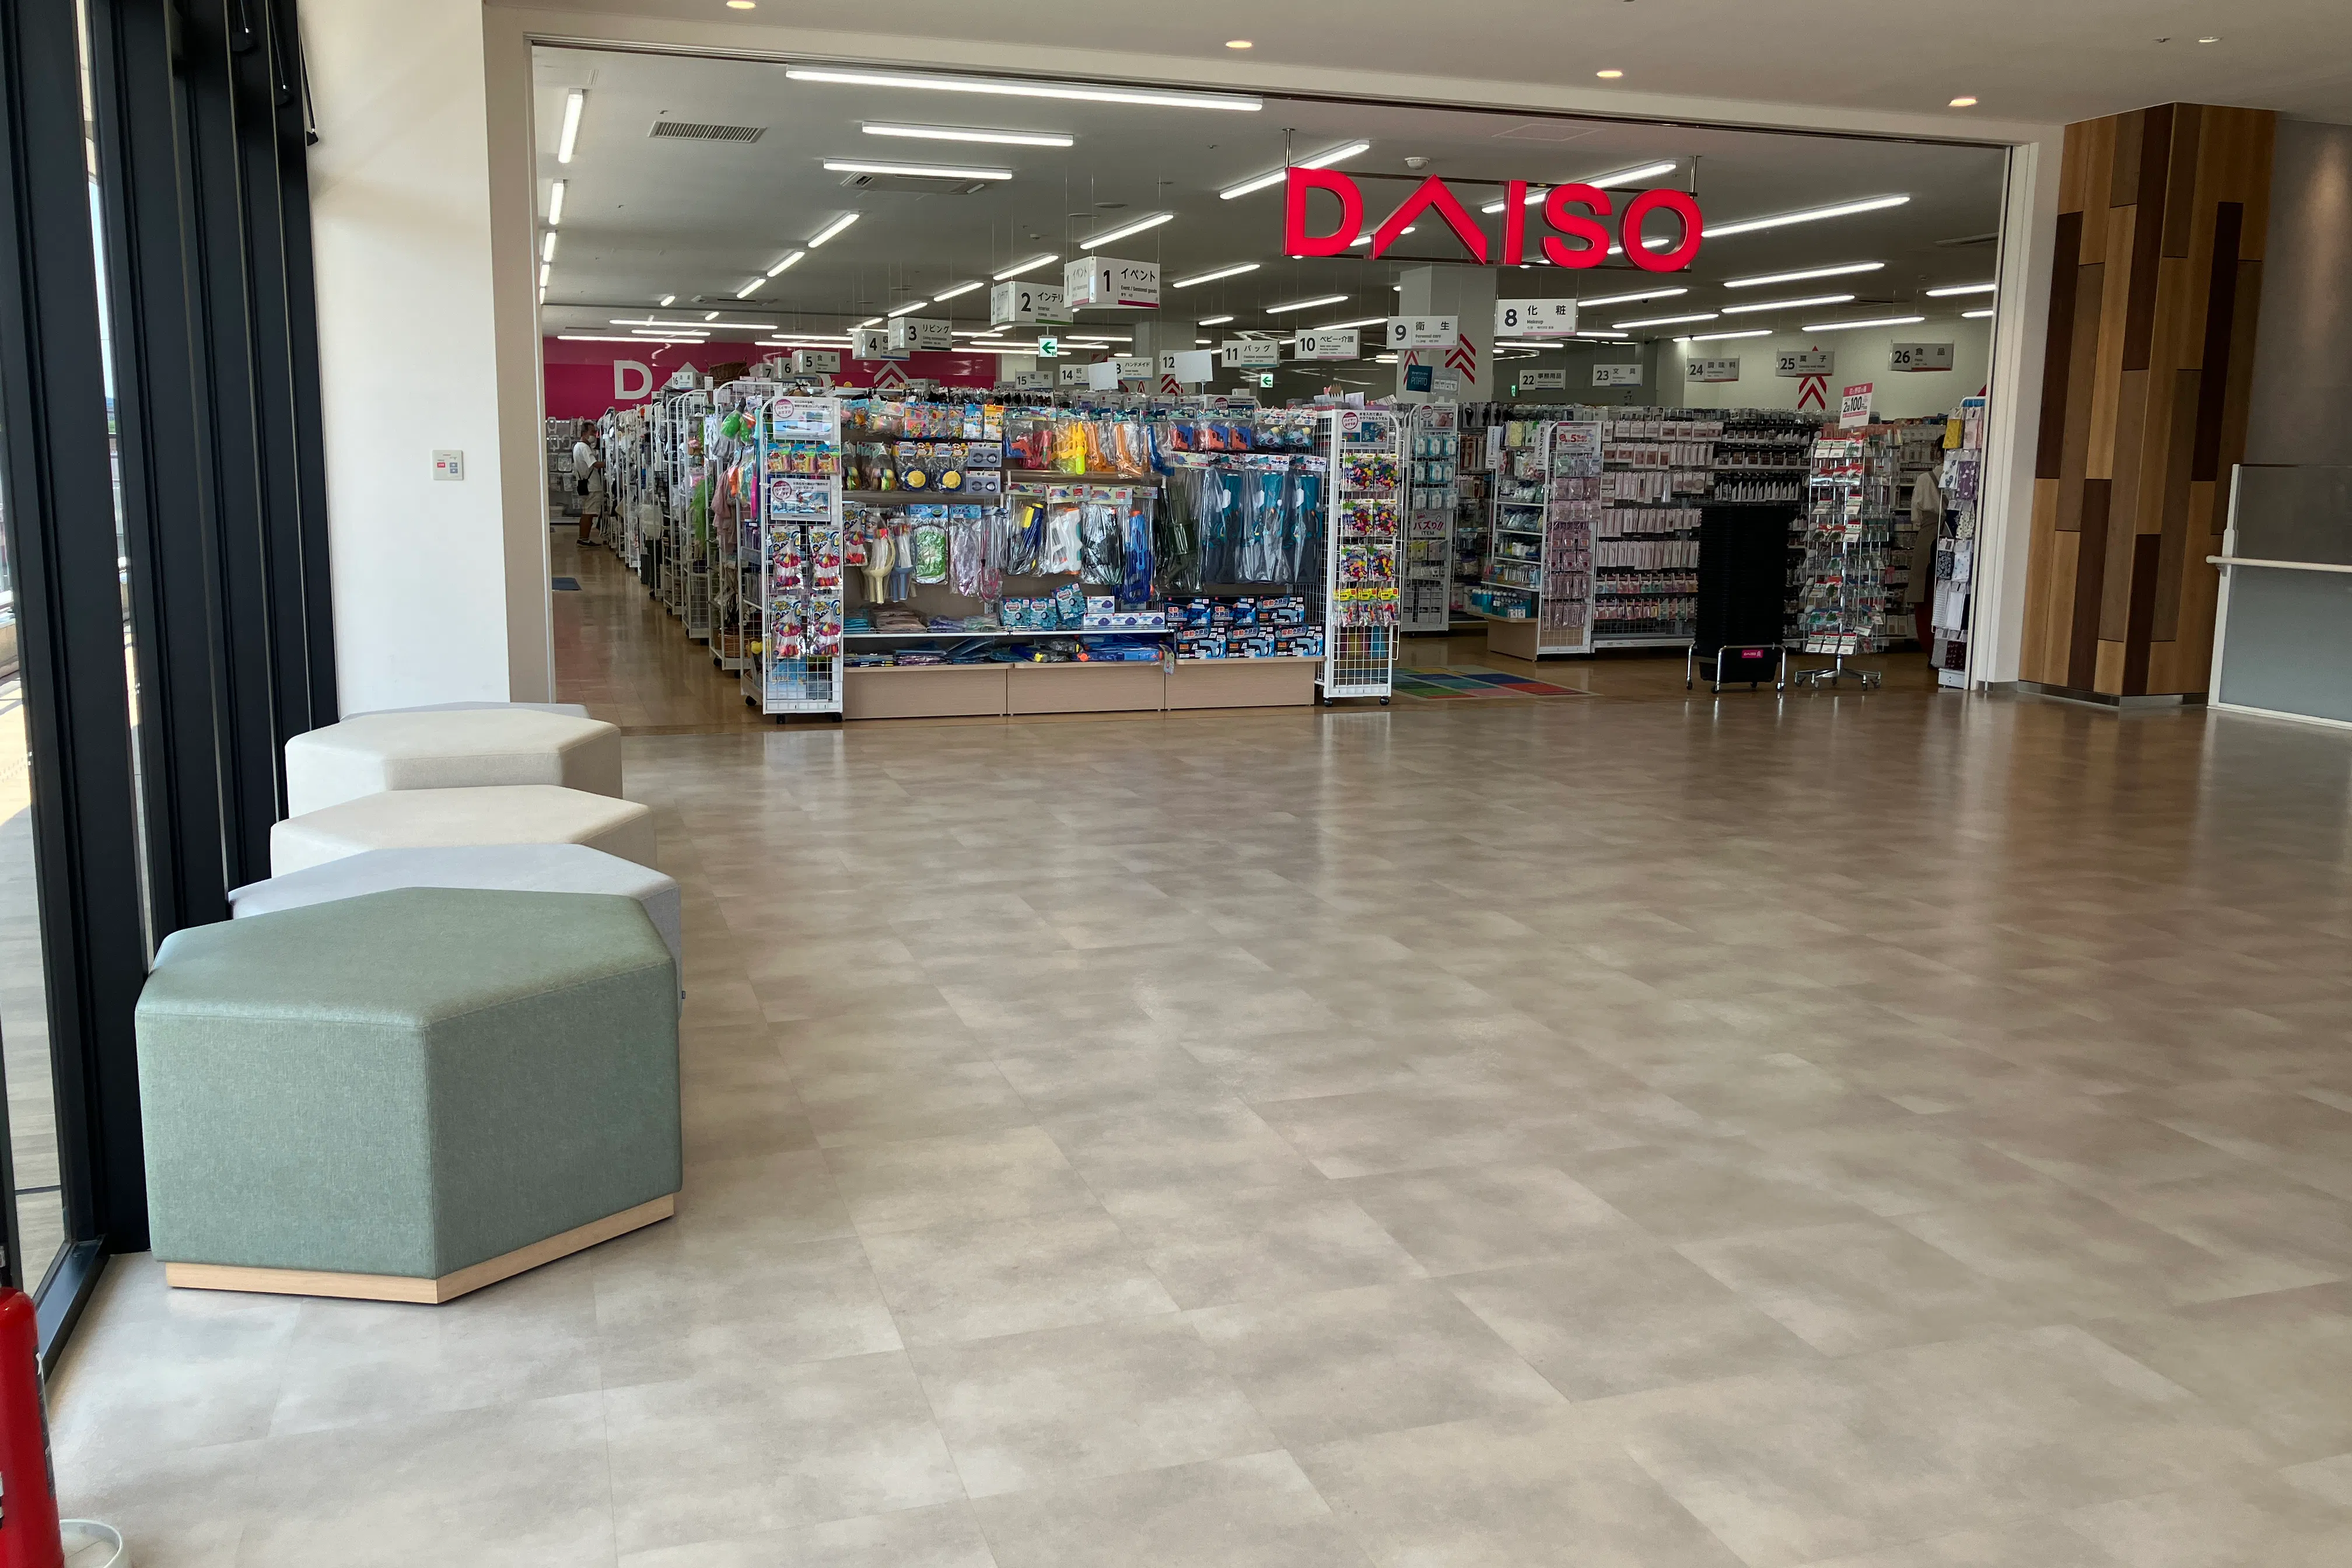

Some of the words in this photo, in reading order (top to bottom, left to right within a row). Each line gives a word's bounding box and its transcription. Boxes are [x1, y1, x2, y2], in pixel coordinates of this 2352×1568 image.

[1283, 167, 1703, 272] DAISO
[1103, 270, 1110, 292] 1
[1121, 268, 1156, 282] イベント
[1021, 292, 1031, 312] 2
[1038, 292, 1063, 303] インテリ
[1527, 305, 1566, 316] 化粧
[1504, 309, 1517, 327] 8
[923, 324, 950, 334] リビング
[1416, 321, 1450, 331] 衛生
[908, 326, 917, 341] 3
[1395, 325, 1406, 341] 9
[869, 338, 877, 351] 4
[1300, 337, 1315, 352] 10
[1226, 348, 1238, 360] 11
[1894, 350, 1910, 363] 26
[806, 356, 813, 367] 5
[1163, 356, 1175, 368] 12
[1780, 358, 1795, 370] 25
[765, 369, 771, 378] 7
[785, 363, 791, 373] 6
[1689, 364, 1703, 376] 24
[673, 377, 678, 385] 16
[1017, 376, 1027, 385] 15
[1062, 370, 1073, 380] 14
[1522, 375, 1534, 385] 22
[1596, 370, 1609, 381] 23
